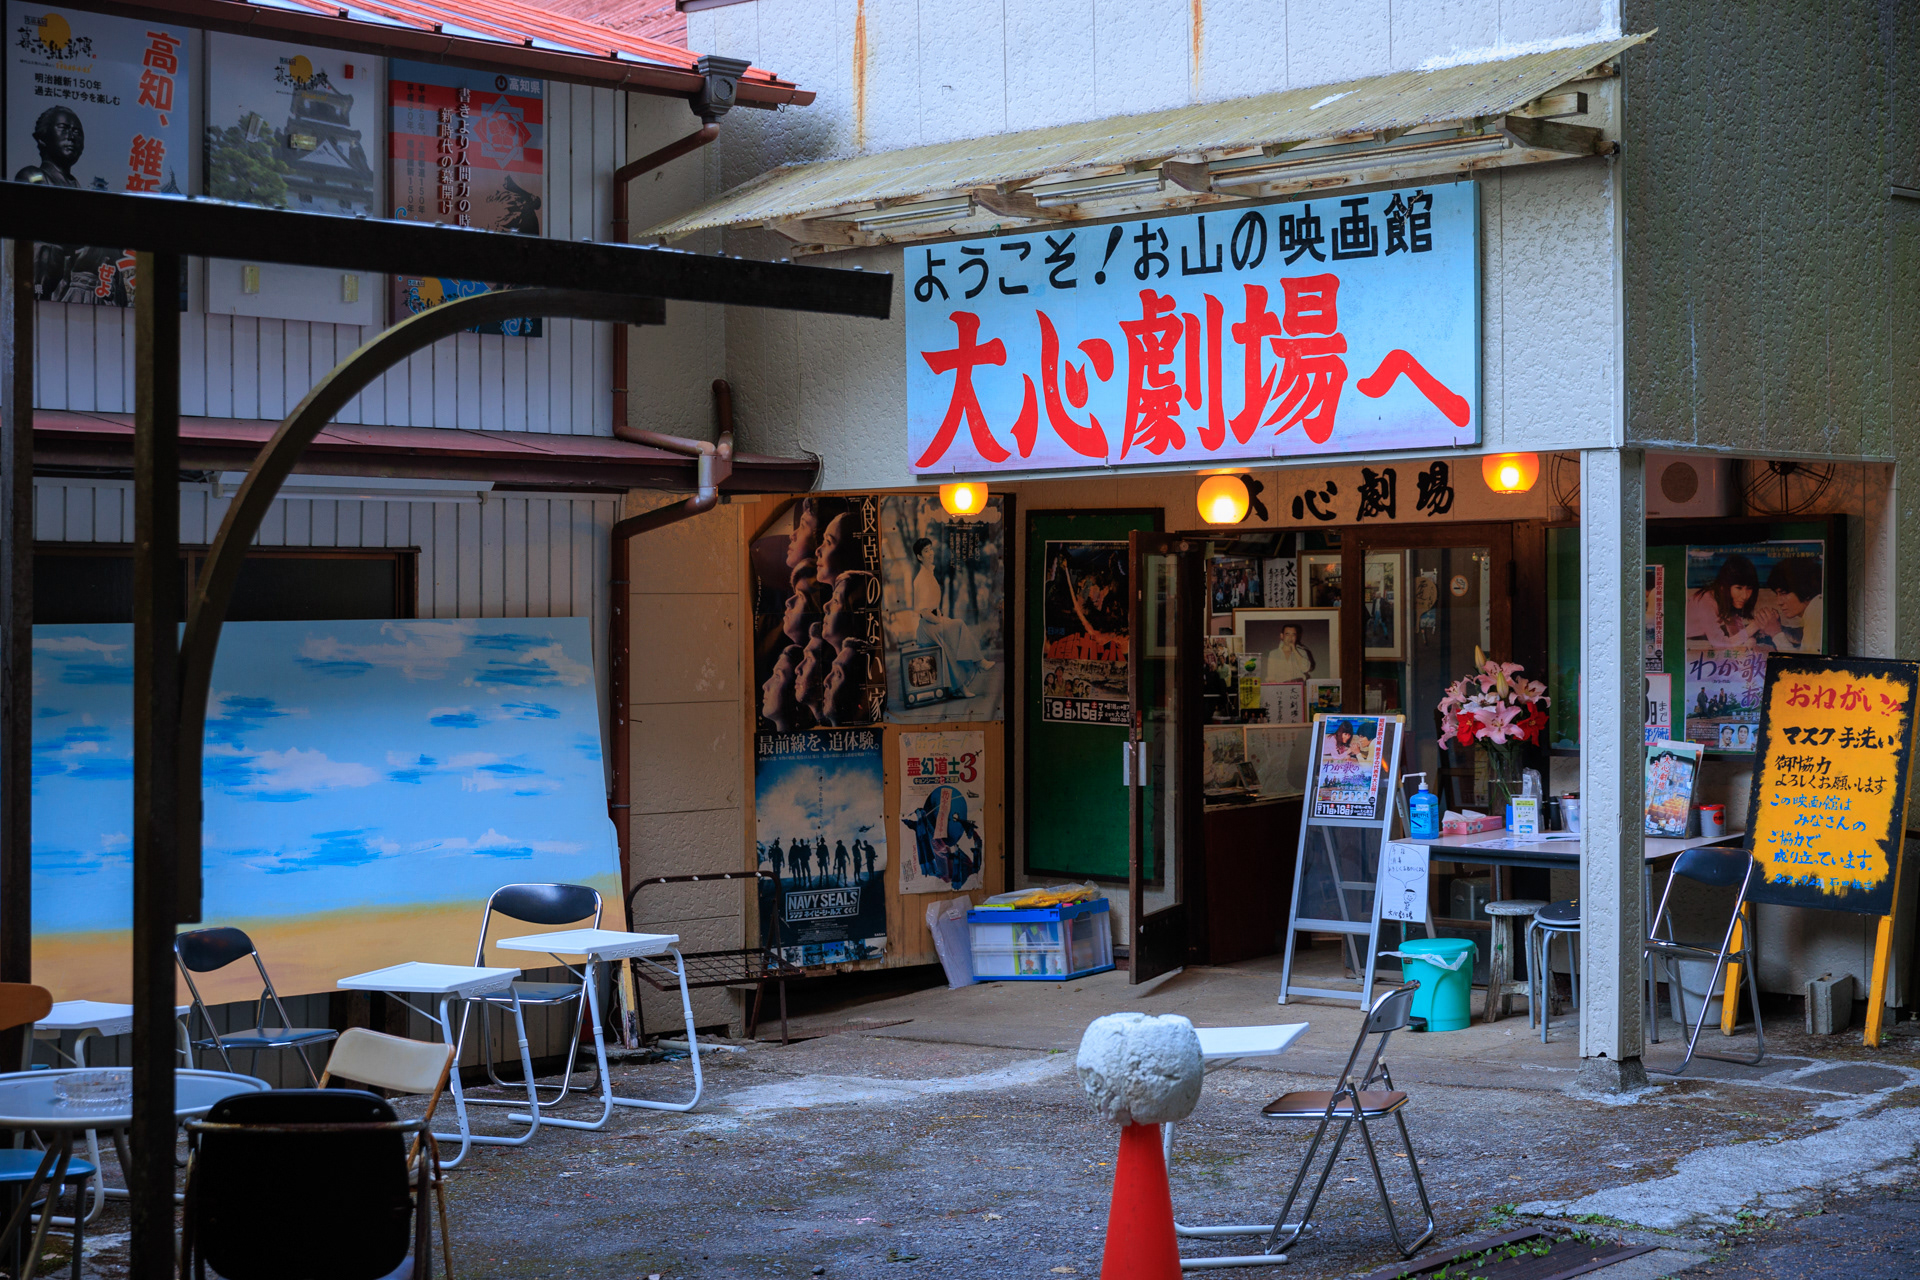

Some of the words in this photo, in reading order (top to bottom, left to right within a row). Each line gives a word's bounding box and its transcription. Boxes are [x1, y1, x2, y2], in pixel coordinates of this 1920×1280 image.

[34, 73, 102, 90] 明治維新150年
[509, 77, 540, 94] 高知県
[34, 86, 121, 106] 過去に学び今を楽しむ
[441, 108, 454, 214] 新時代の幕開け
[95, 263, 116, 298] ぜよ
[915, 273, 1470, 468] 大心劇場へ
[862, 497, 884, 722] 食卓のない家
[758, 731, 880, 755] 最前線を、追体験。
[907, 752, 978, 782] 霊幻道士3
[1775, 754, 1832, 775] 御協力
[1775, 774, 1887, 795] よろしくお願いします
[1770, 793, 1853, 811] この映画館は
[1794, 813, 1867, 832] みなさんの
[1767, 830, 1822, 848] ご協力で
[789, 895, 819, 910] NAVY
[820, 891, 858, 907] SEALS
